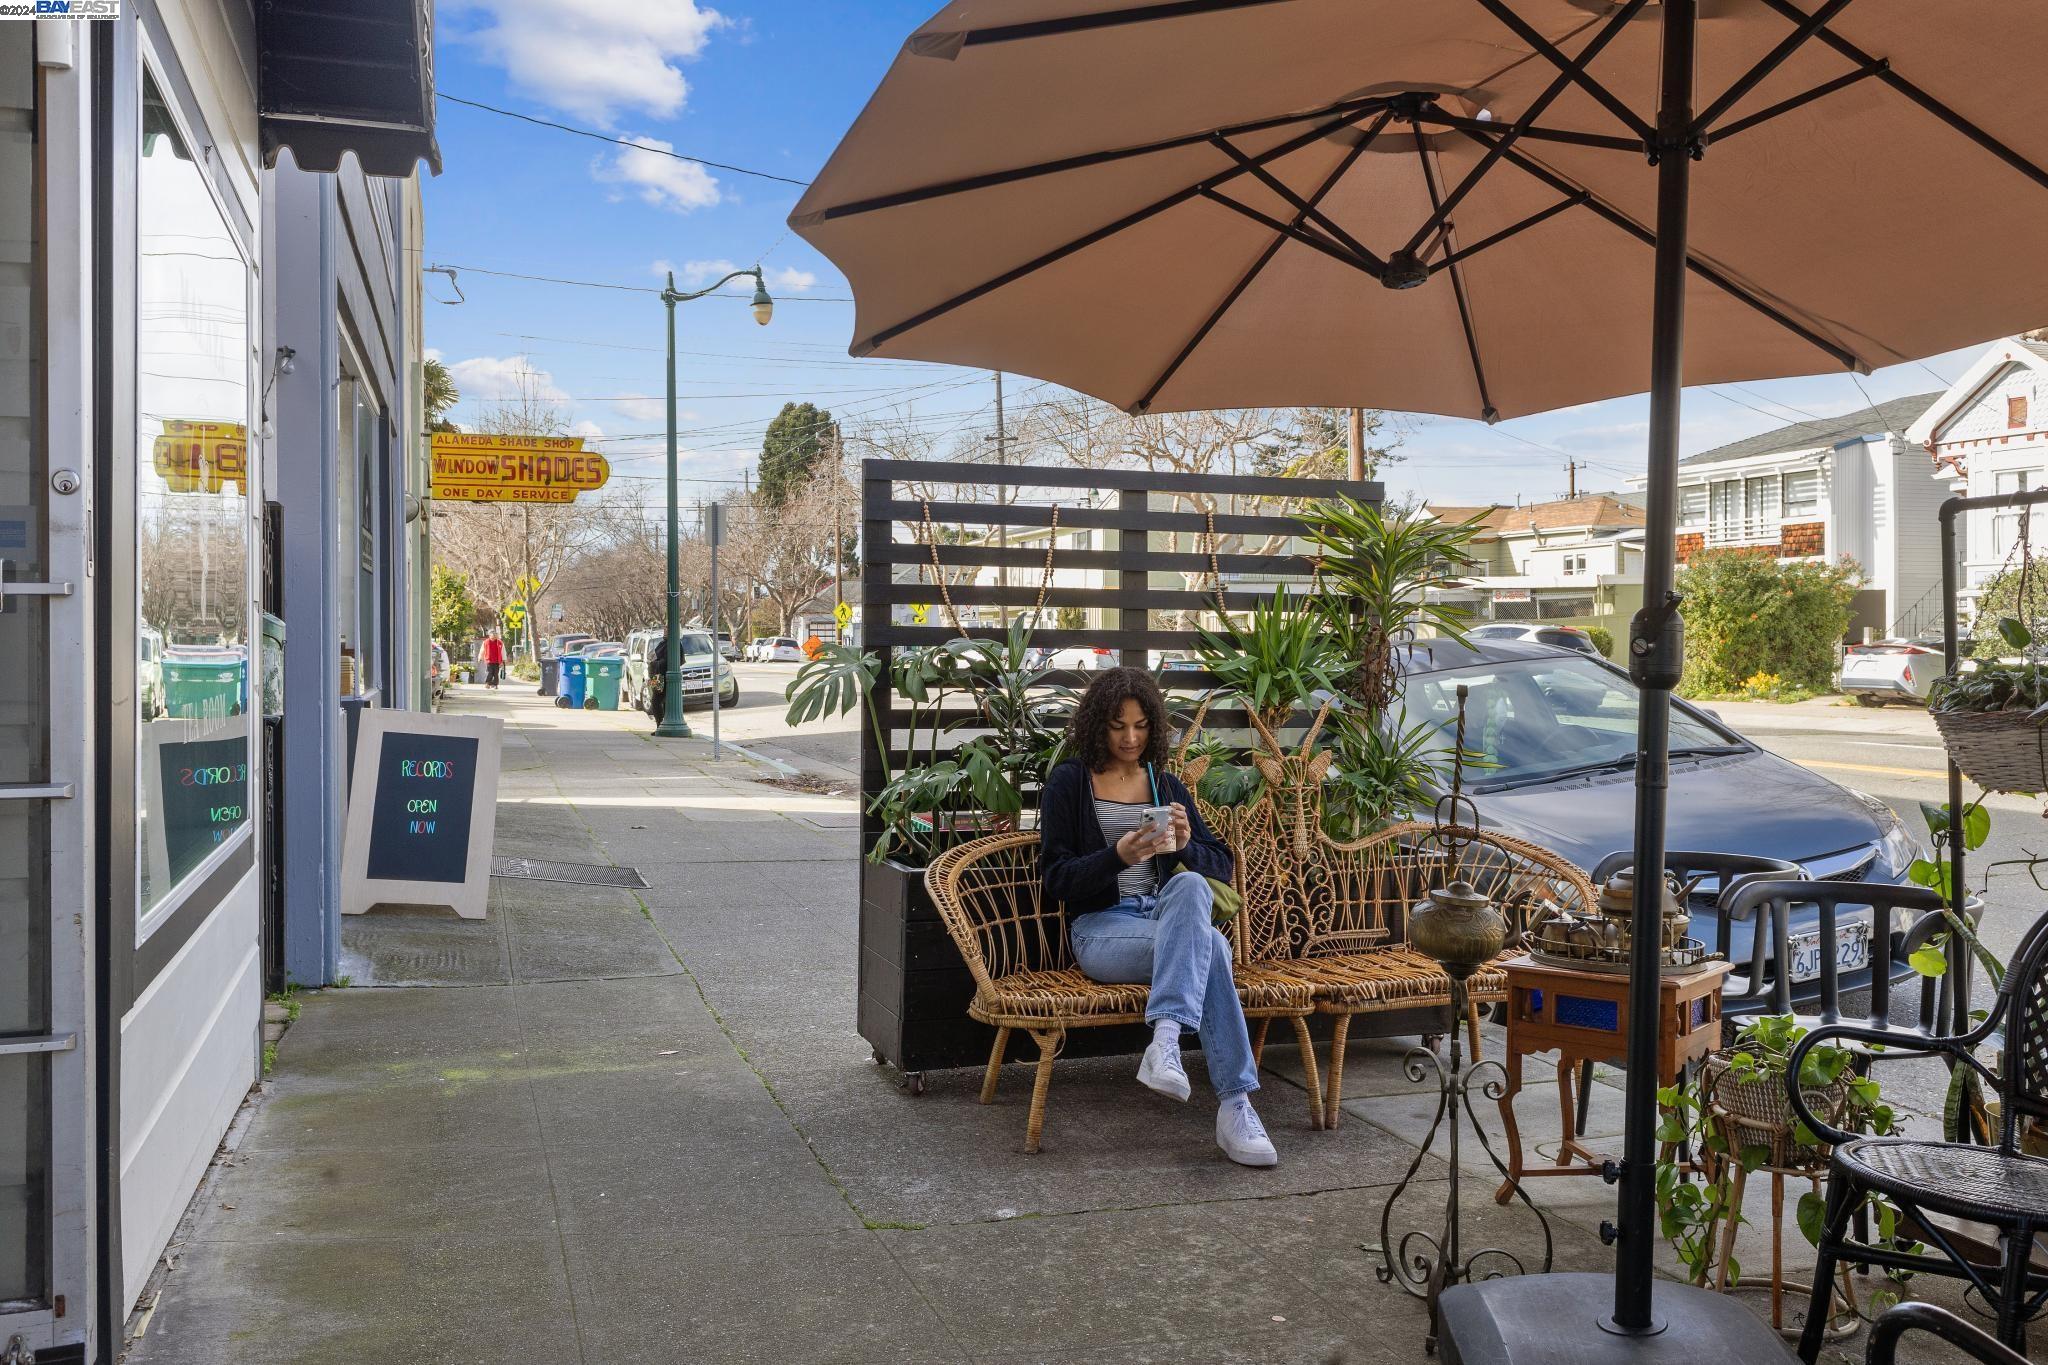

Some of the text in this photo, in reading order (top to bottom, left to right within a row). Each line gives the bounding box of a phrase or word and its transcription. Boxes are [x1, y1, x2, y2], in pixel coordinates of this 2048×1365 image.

[436, 435, 575, 449] ALAMEDA SHADE SHOP
[501, 455, 602, 484] SHADES
[442, 488, 569, 500] ONE DAY SERVICE
[401, 759, 454, 779] RECORDS
[407, 799, 437, 813] OPEN
[409, 820, 436, 834] NOW
